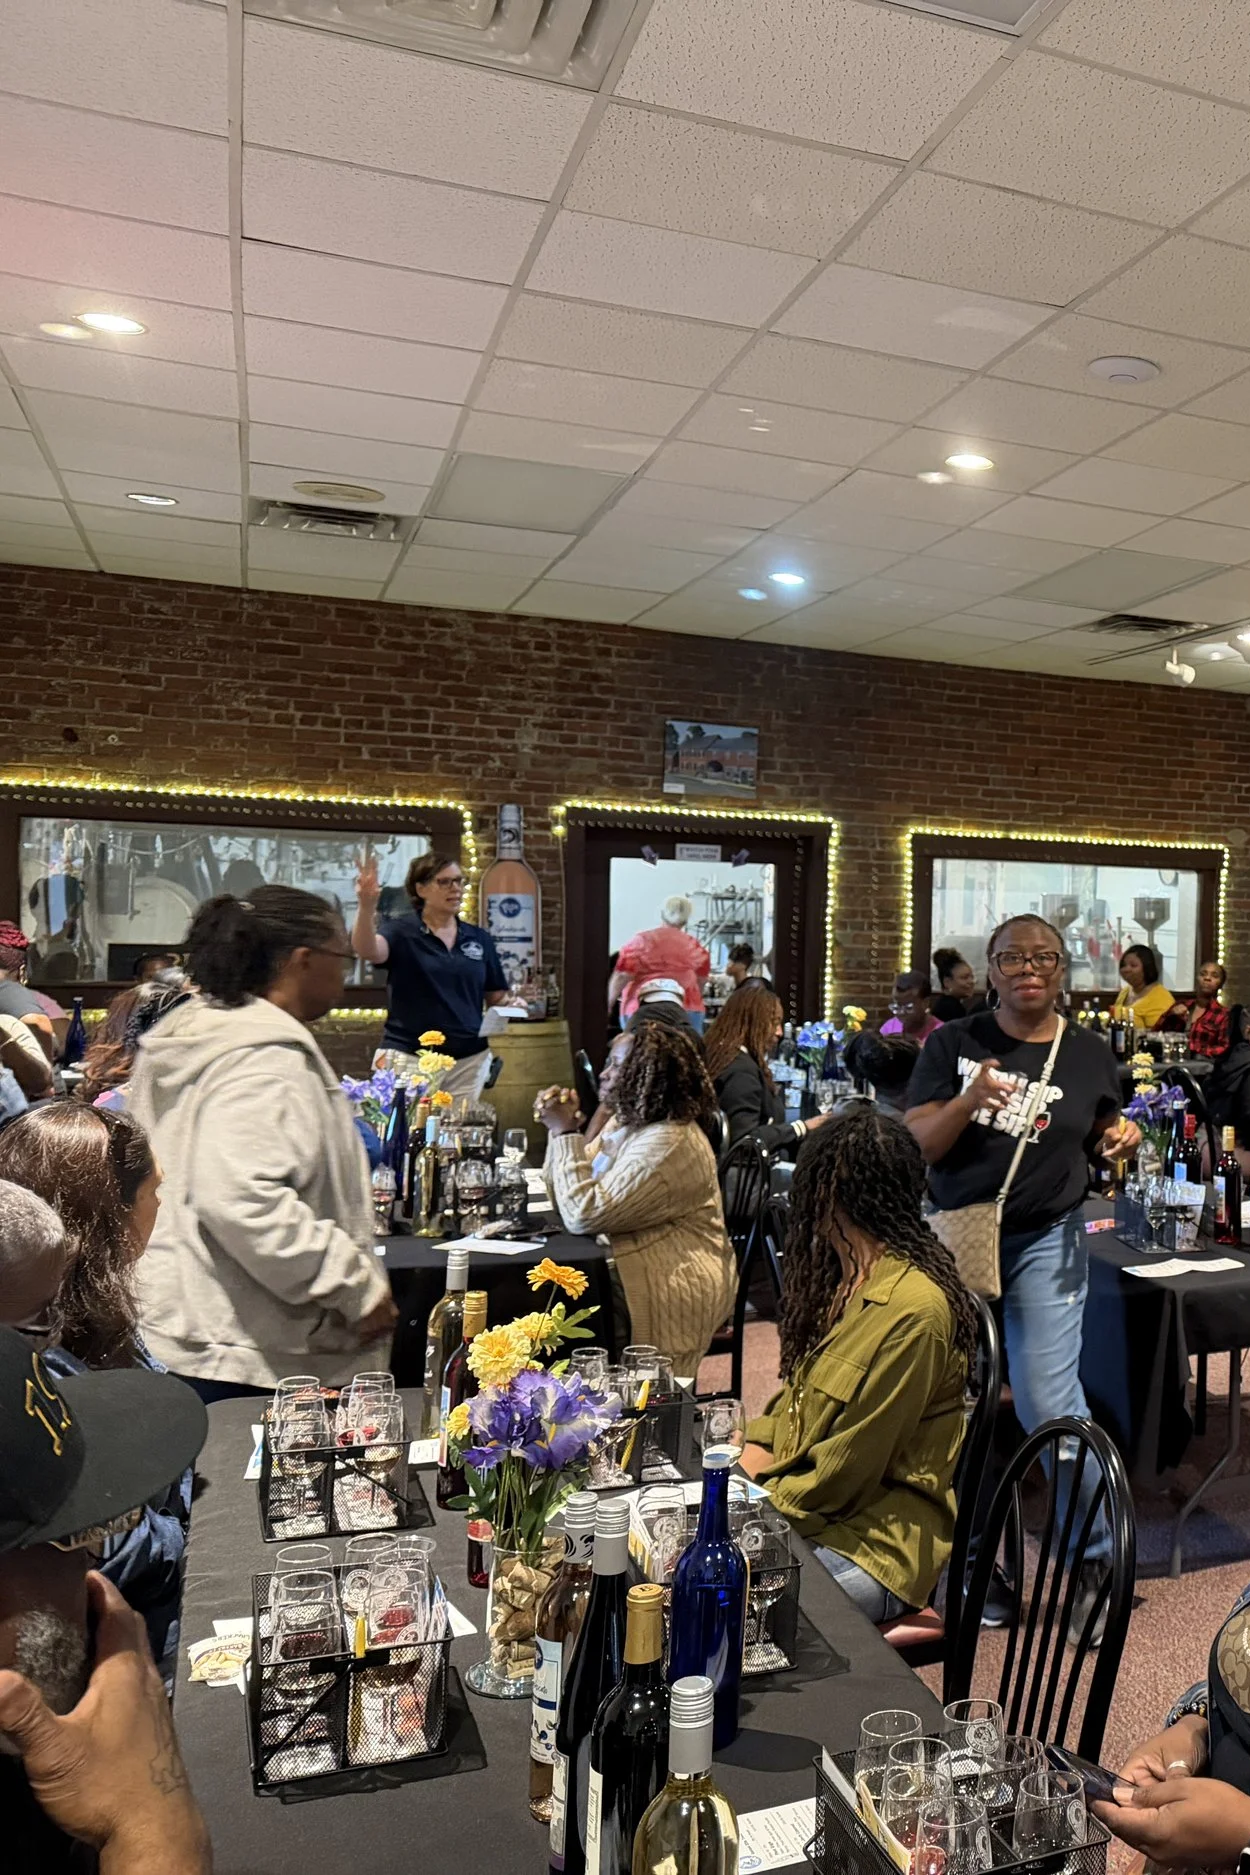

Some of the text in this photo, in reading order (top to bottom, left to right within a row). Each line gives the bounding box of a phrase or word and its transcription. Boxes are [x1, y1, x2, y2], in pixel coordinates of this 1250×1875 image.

[1027, 1081, 1064, 1104] SIP
[970, 1107, 993, 1126] E
[1241, 1627, 1249, 1650] HOUSE
